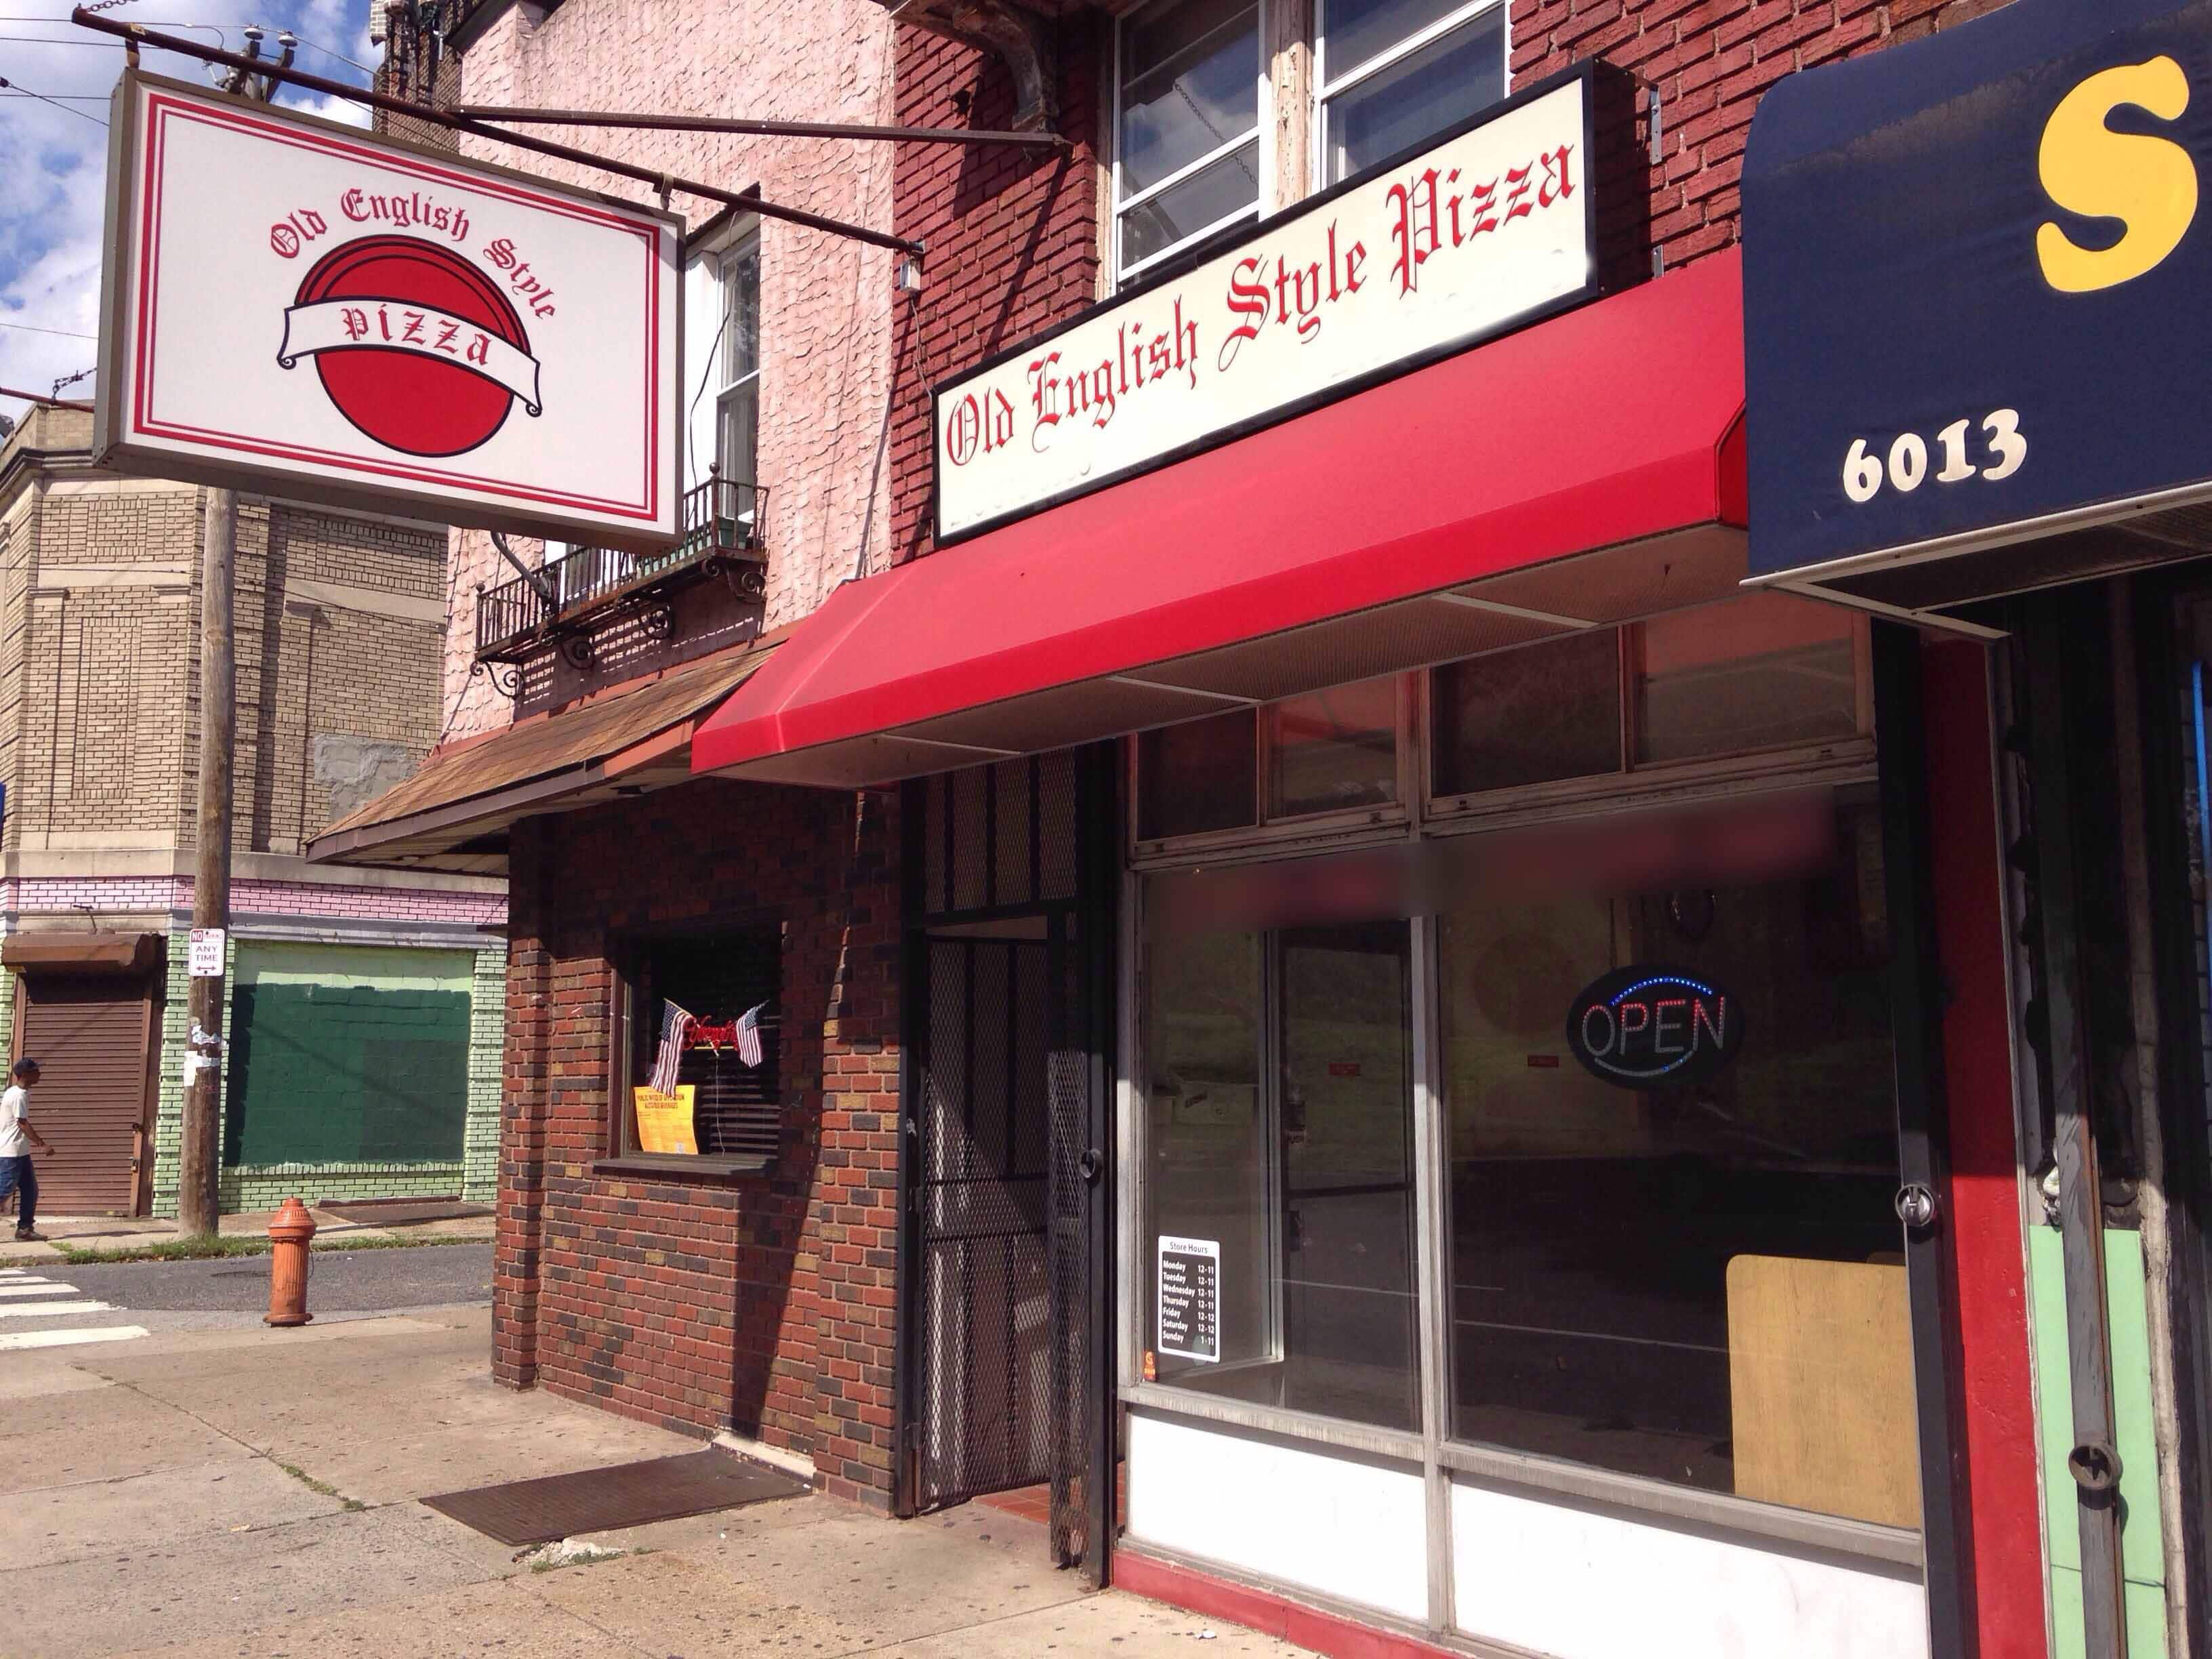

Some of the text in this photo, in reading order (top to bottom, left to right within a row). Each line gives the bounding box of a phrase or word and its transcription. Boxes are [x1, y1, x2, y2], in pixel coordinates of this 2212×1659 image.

[2035, 54, 2198, 292] S
[270, 187, 556, 320] Old English Style
[946, 144, 1574, 466] Old English Style Pizza
[1843, 408, 2028, 503] 6013
[192, 932, 203, 941] NO
[1582, 996, 1726, 1057] OPEN
[1170, 1242, 1208, 1254] Store Hours
[1163, 1260, 1214, 1275] Monday 12-11
[1163, 1271, 1214, 1286] Tuesday 12-11
[1163, 1284, 1214, 1298] Wednesday 12-11
[1163, 1295, 1214, 1310] Thursday 12-11
[1163, 1307, 1214, 1322] Friday 12-12
[1163, 1318, 1214, 1334] Saturday 12-12
[1163, 1330, 1214, 1346] Sunday 1-11
